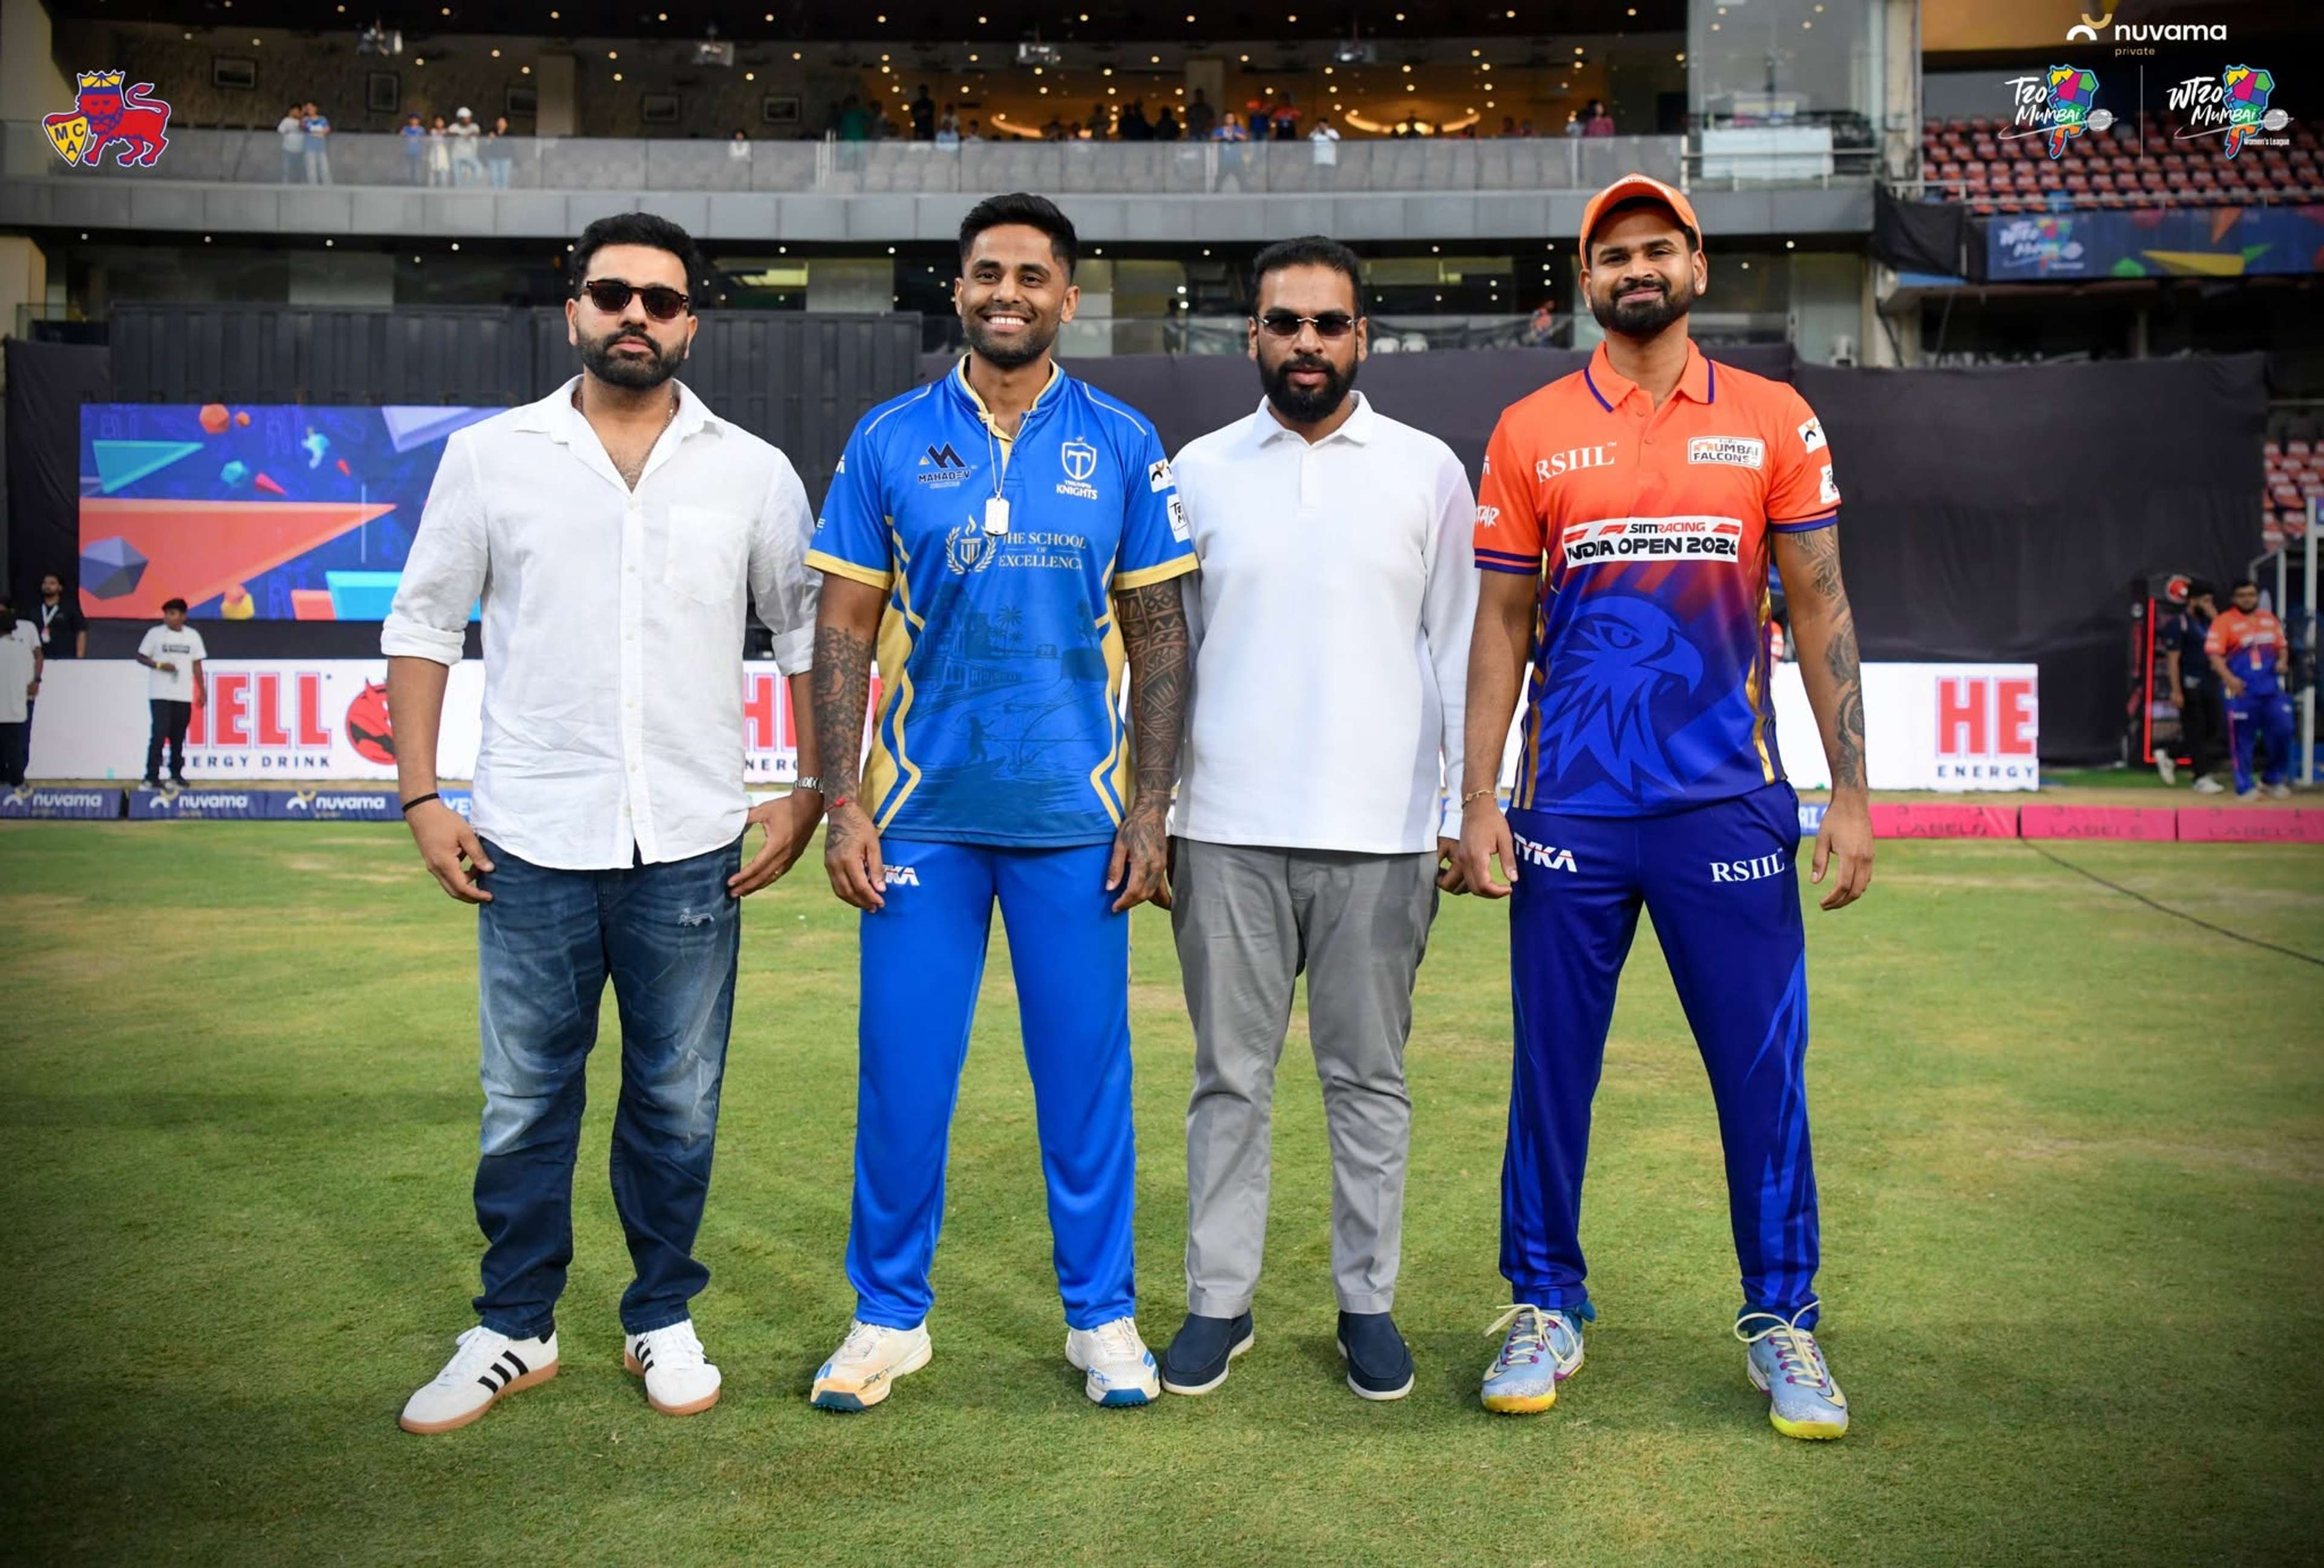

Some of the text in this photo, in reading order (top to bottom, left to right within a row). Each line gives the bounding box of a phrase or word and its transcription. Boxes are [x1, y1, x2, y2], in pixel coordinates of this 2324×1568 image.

[1693, 452, 1750, 463] FALCONS
[1055, 484, 1098, 500] KNIGHTS
[1475, 504, 1500, 528] TAR
[1028, 531, 1087, 549] SCHOOL
[1618, 536, 1682, 555] OPEN
[999, 554, 1082, 570] EXCELLENC
[182, 756, 330, 768] ERGY DRINK
[1937, 765, 2034, 778] ENERGY
[32, 793, 103, 807] nuvama
[179, 795, 249, 809] nuvama
[315, 796, 386, 810] nuvama
[1709, 853, 1785, 883] RSIIL
